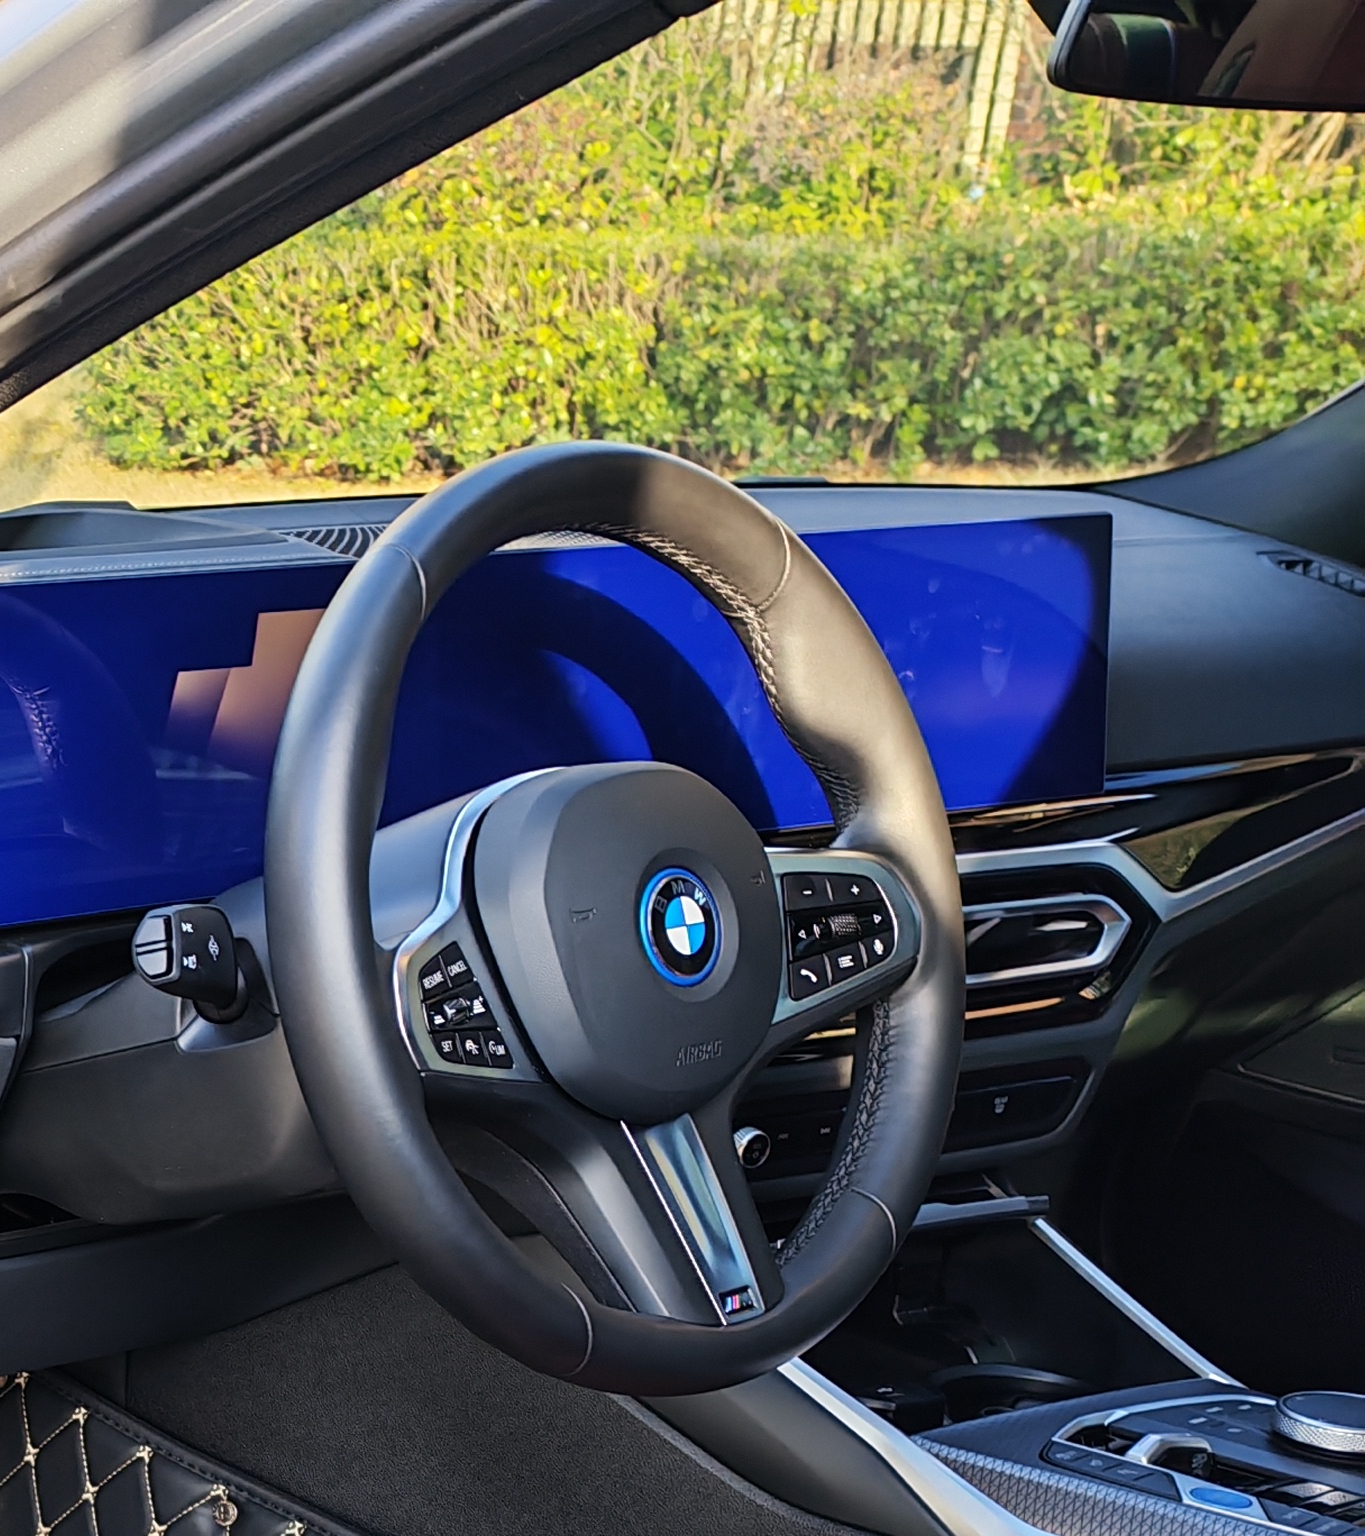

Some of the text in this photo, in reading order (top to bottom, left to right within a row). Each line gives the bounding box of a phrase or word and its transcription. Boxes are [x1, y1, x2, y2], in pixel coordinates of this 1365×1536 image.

[654, 880, 706, 913] BMW
[447, 960, 468, 977] CANCEL
[441, 1040, 453, 1053] SET
[676, 1040, 722, 1067] AIRBAG
